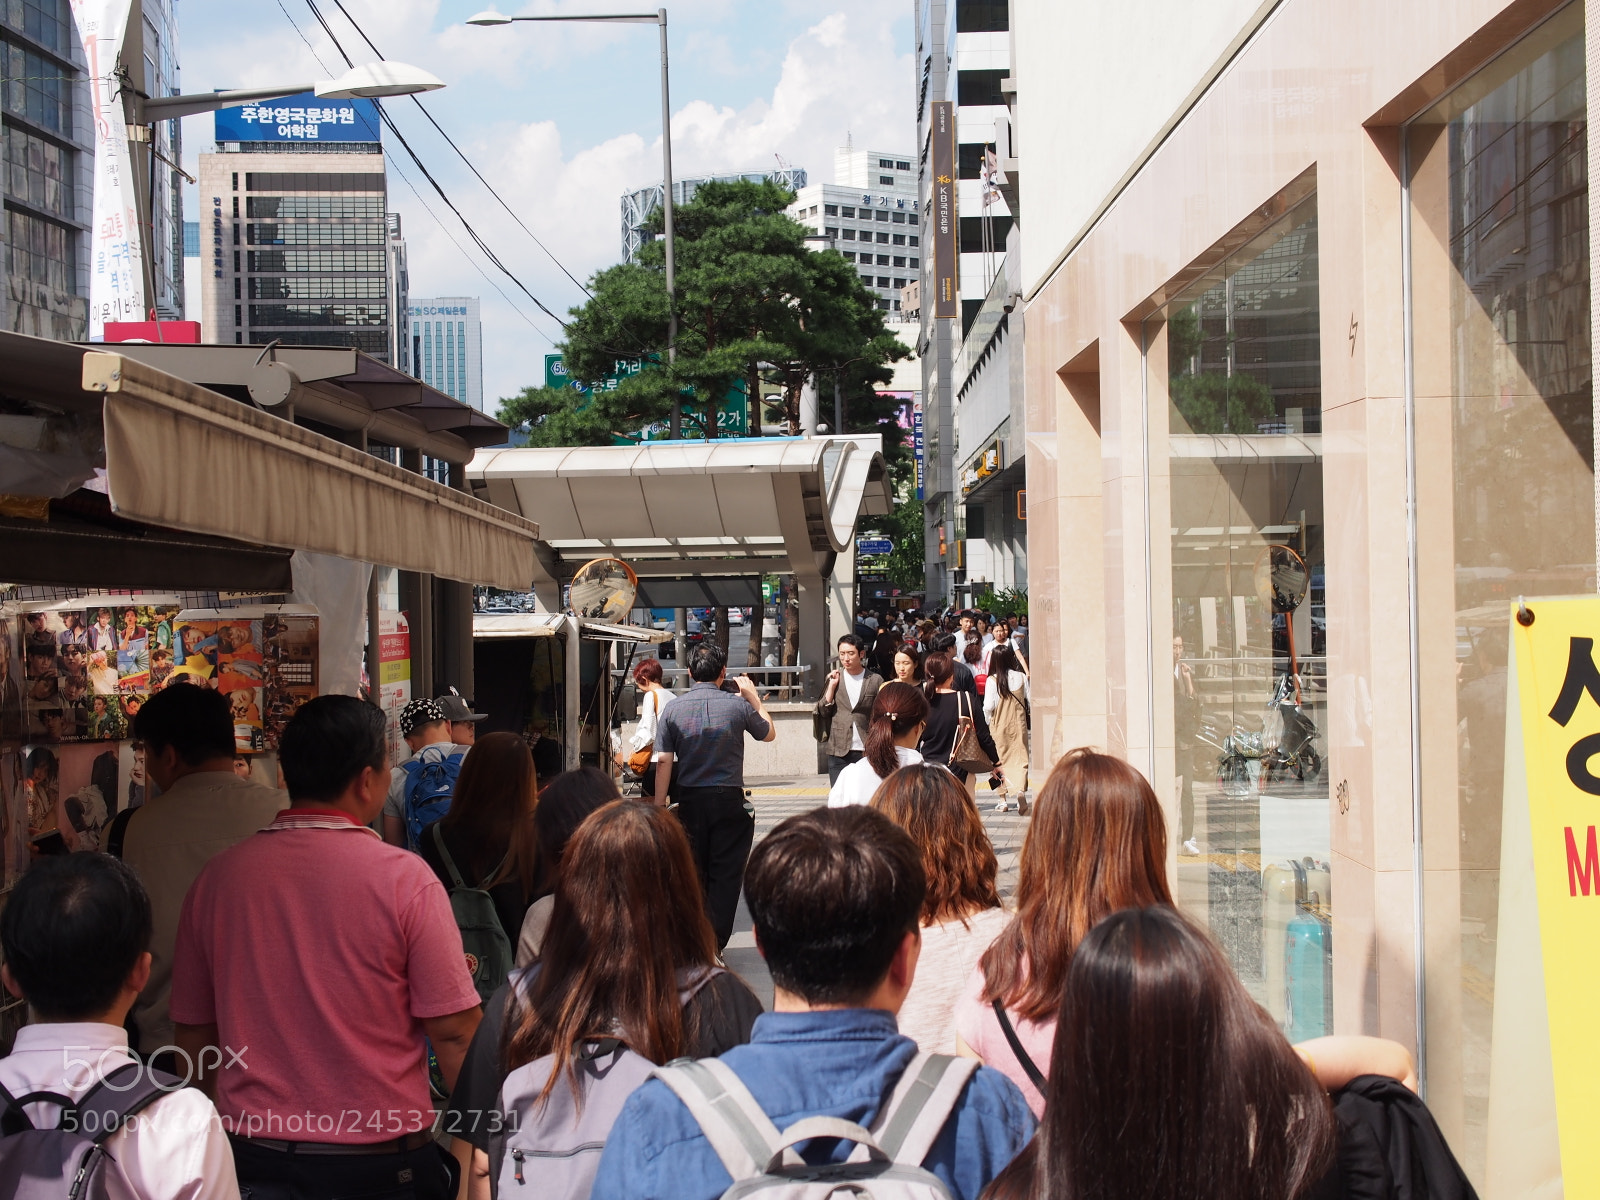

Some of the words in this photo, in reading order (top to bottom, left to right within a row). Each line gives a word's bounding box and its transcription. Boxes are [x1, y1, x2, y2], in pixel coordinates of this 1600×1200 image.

[241, 107, 354, 124] 주한영국문화원
[277, 124, 319, 138] 어학원
[940, 186, 948, 234] KB국민은행
[575, 381, 582, 392] 6
